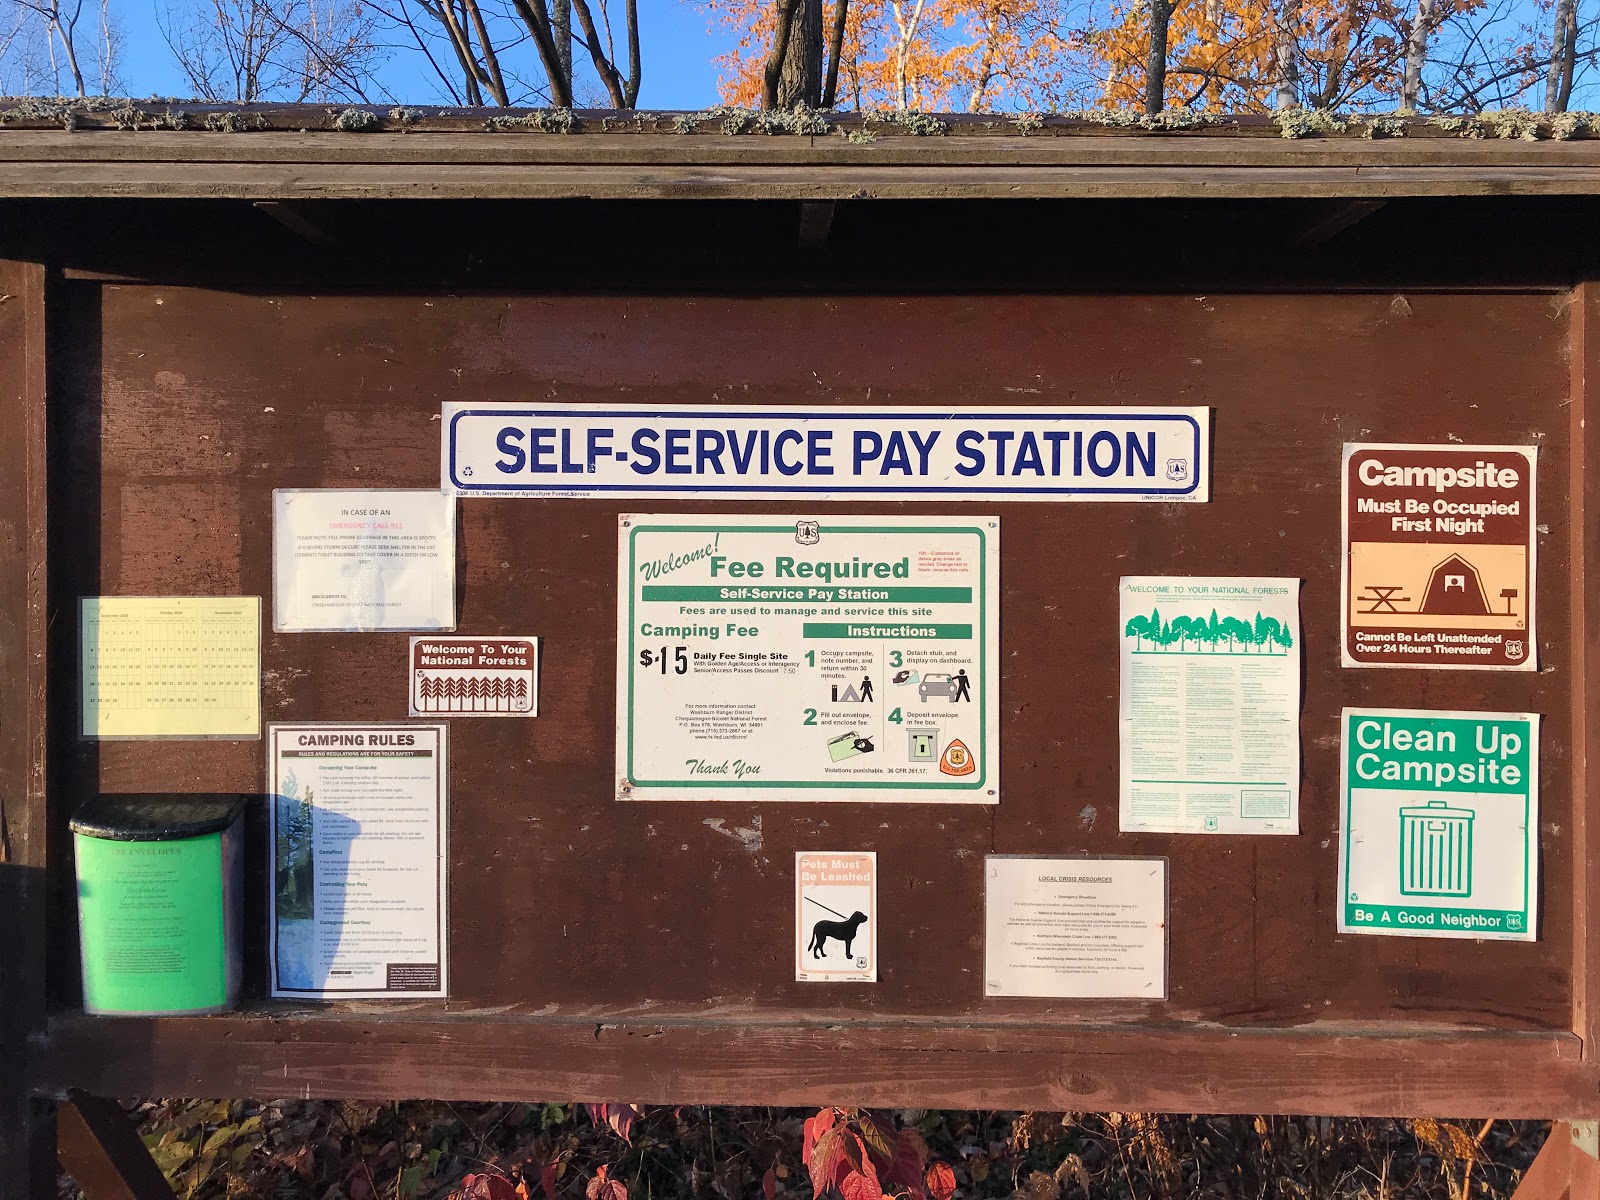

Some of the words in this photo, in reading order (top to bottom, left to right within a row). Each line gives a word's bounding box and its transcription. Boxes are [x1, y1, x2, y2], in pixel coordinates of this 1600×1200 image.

[495, 427, 833, 476] SELF-SERVICE
[853, 430, 942, 476] PAY
[954, 430, 1156, 478] STATION
[1359, 459, 1519, 493] Campsite
[1358, 499, 1401, 514] Must
[1405, 499, 1430, 514] Be
[1433, 500, 1519, 517] Occupied
[1392, 517, 1431, 532] First
[1436, 518, 1484, 535] Night
[640, 533, 719, 581] Welcome!
[710, 556, 764, 578] Fee
[776, 557, 908, 583] Required
[720, 588, 803, 599] Self-Service
[808, 589, 833, 601] Pay
[838, 589, 889, 600] Station
[774, 608, 817, 617] manage
[844, 608, 884, 616] service
[888, 608, 908, 616] this
[912, 608, 932, 616] site
[641, 623, 719, 640] Camping
[727, 624, 759, 636] Fee
[848, 625, 936, 637] Instructions
[1356, 632, 1394, 642] Cannot
[1397, 632, 1412, 642] Be
[1414, 633, 1435, 643] Left
[1437, 634, 1502, 644] Unattended
[422, 645, 475, 653] Welcome
[481, 645, 494, 653] To
[501, 645, 527, 654] Your
[694, 652, 716, 660] Daily
[1356, 644, 1381, 653] Over
[1384, 644, 1397, 653] 24
[1399, 644, 1431, 654] Hours
[1434, 645, 1492, 655] Thereafter
[421, 656, 472, 665] National
[479, 656, 527, 665] Forests
[805, 650, 815, 667] 1
[889, 650, 903, 667] 3
[803, 708, 817, 725] 2
[888, 708, 903, 724] 4
[298, 735, 364, 746] CAMPING
[369, 735, 415, 746] RULES
[1356, 721, 1456, 752] Clean
[1476, 726, 1522, 759] Up
[686, 759, 729, 774] Thank
[733, 759, 761, 779] You
[1356, 753, 1521, 787] Campsite
[802, 860, 827, 869] Pets
[832, 860, 860, 869] Must
[802, 873, 816, 881] Be
[821, 873, 870, 881] Leashed
[1078, 876, 1112, 884] RESOURCES
[1355, 909, 1374, 921] Be
[1381, 911, 1391, 922] A
[1398, 912, 1434, 924] Good
[1441, 912, 1501, 928] Neighbor
